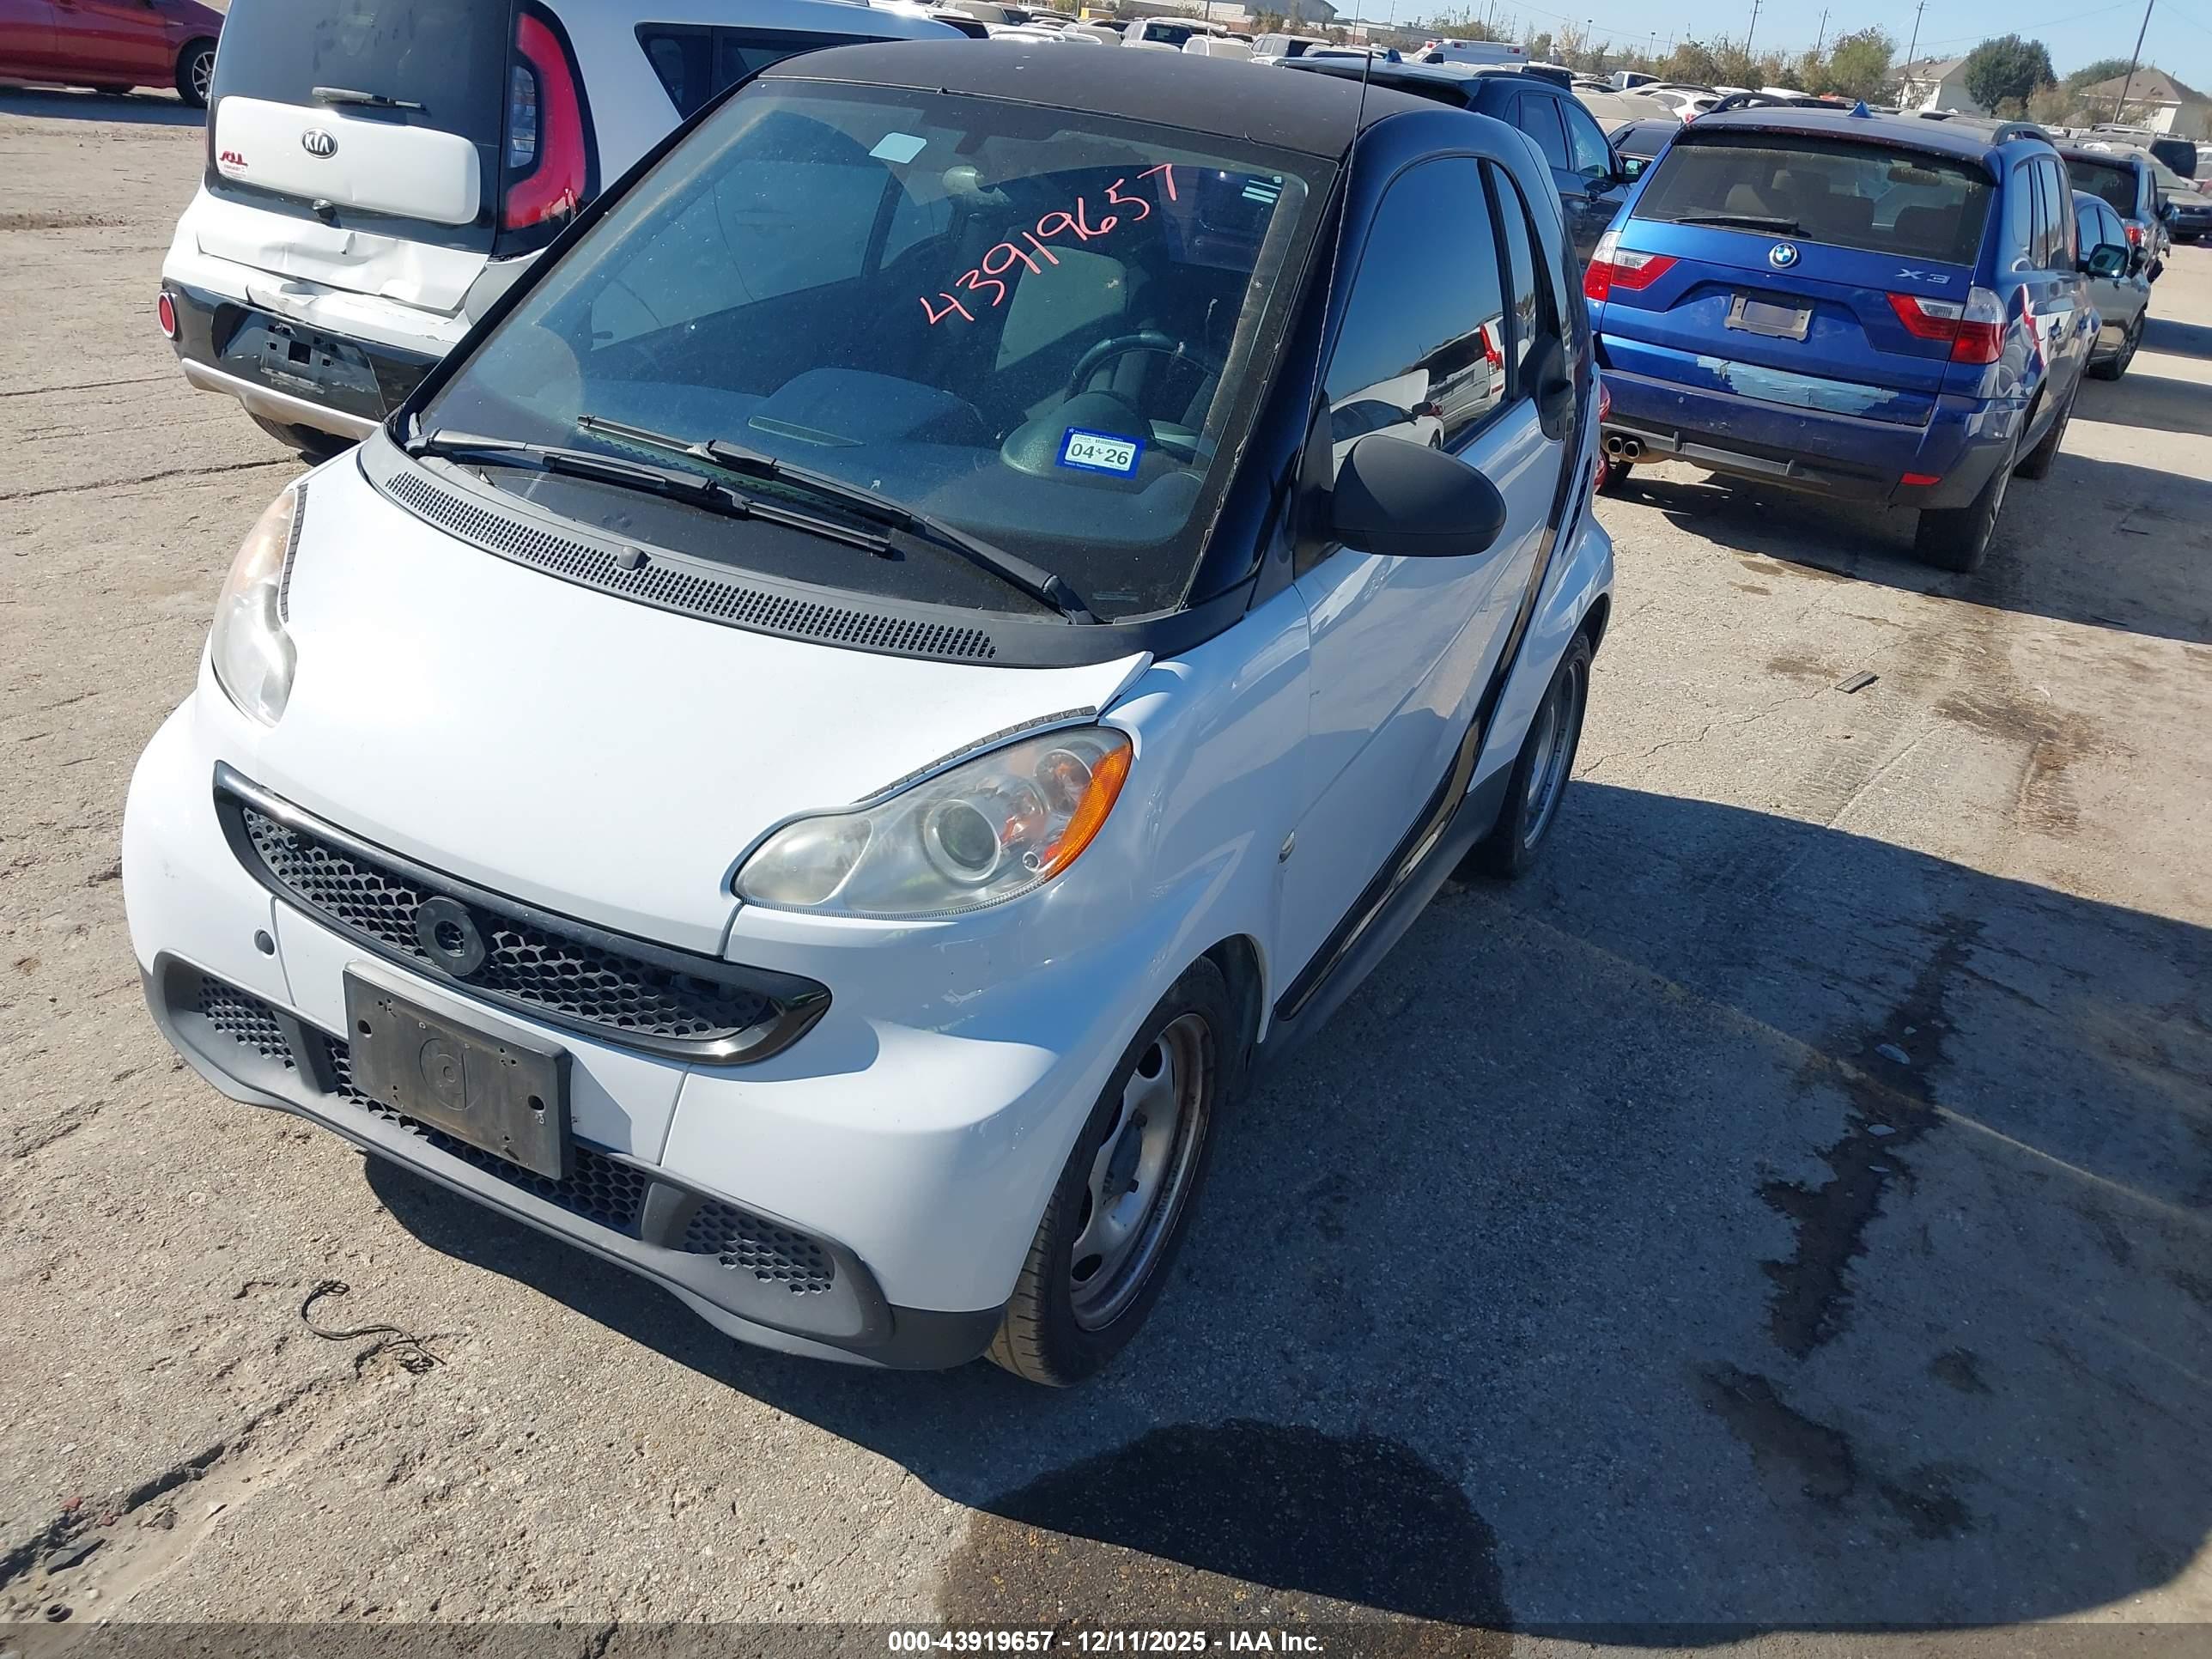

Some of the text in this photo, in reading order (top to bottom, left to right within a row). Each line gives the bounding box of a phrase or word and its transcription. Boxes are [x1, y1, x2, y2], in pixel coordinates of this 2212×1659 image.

[305, 134, 330, 153] KIA
[920, 163, 1177, 325] 43919657
[1895, 268, 1951, 284] X3
[1071, 443, 1130, 465] 04 26
